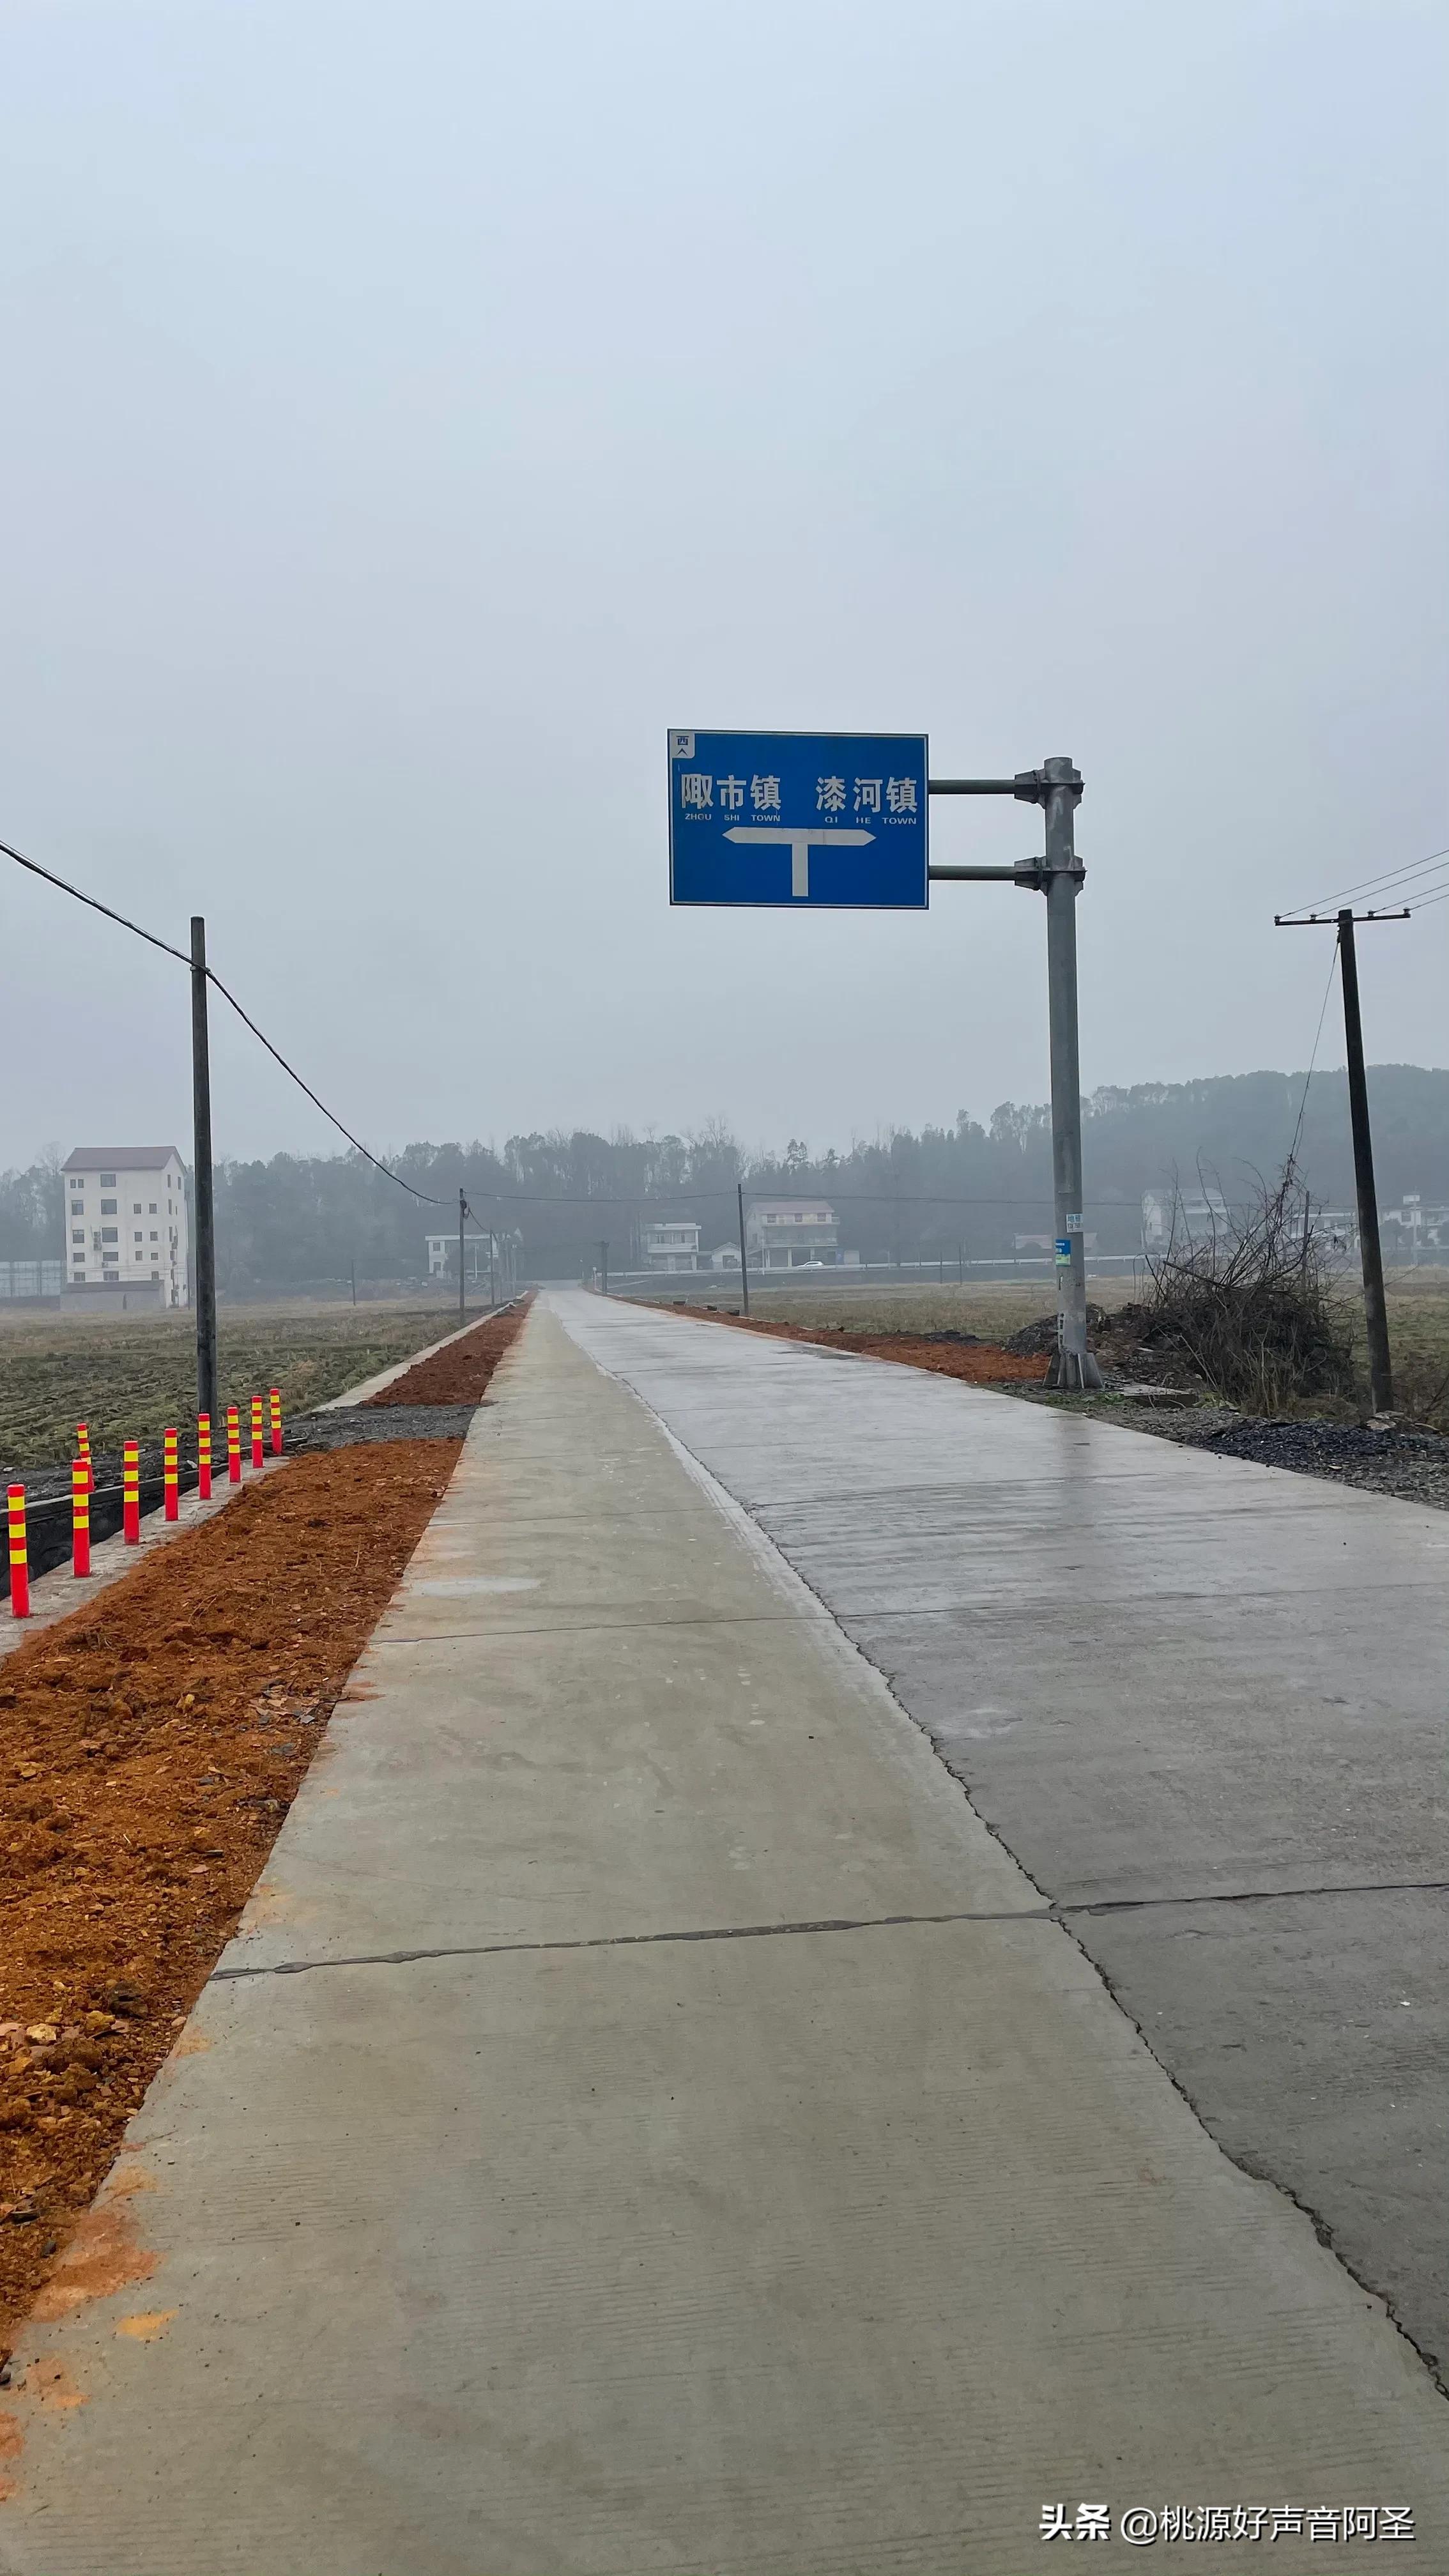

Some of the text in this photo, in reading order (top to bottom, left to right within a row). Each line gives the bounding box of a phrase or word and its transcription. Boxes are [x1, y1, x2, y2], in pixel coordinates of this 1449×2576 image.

[675, 735, 689, 746] 西
[681, 773, 781, 810] 陬市镇
[816, 776, 917, 813] 漆河镇
